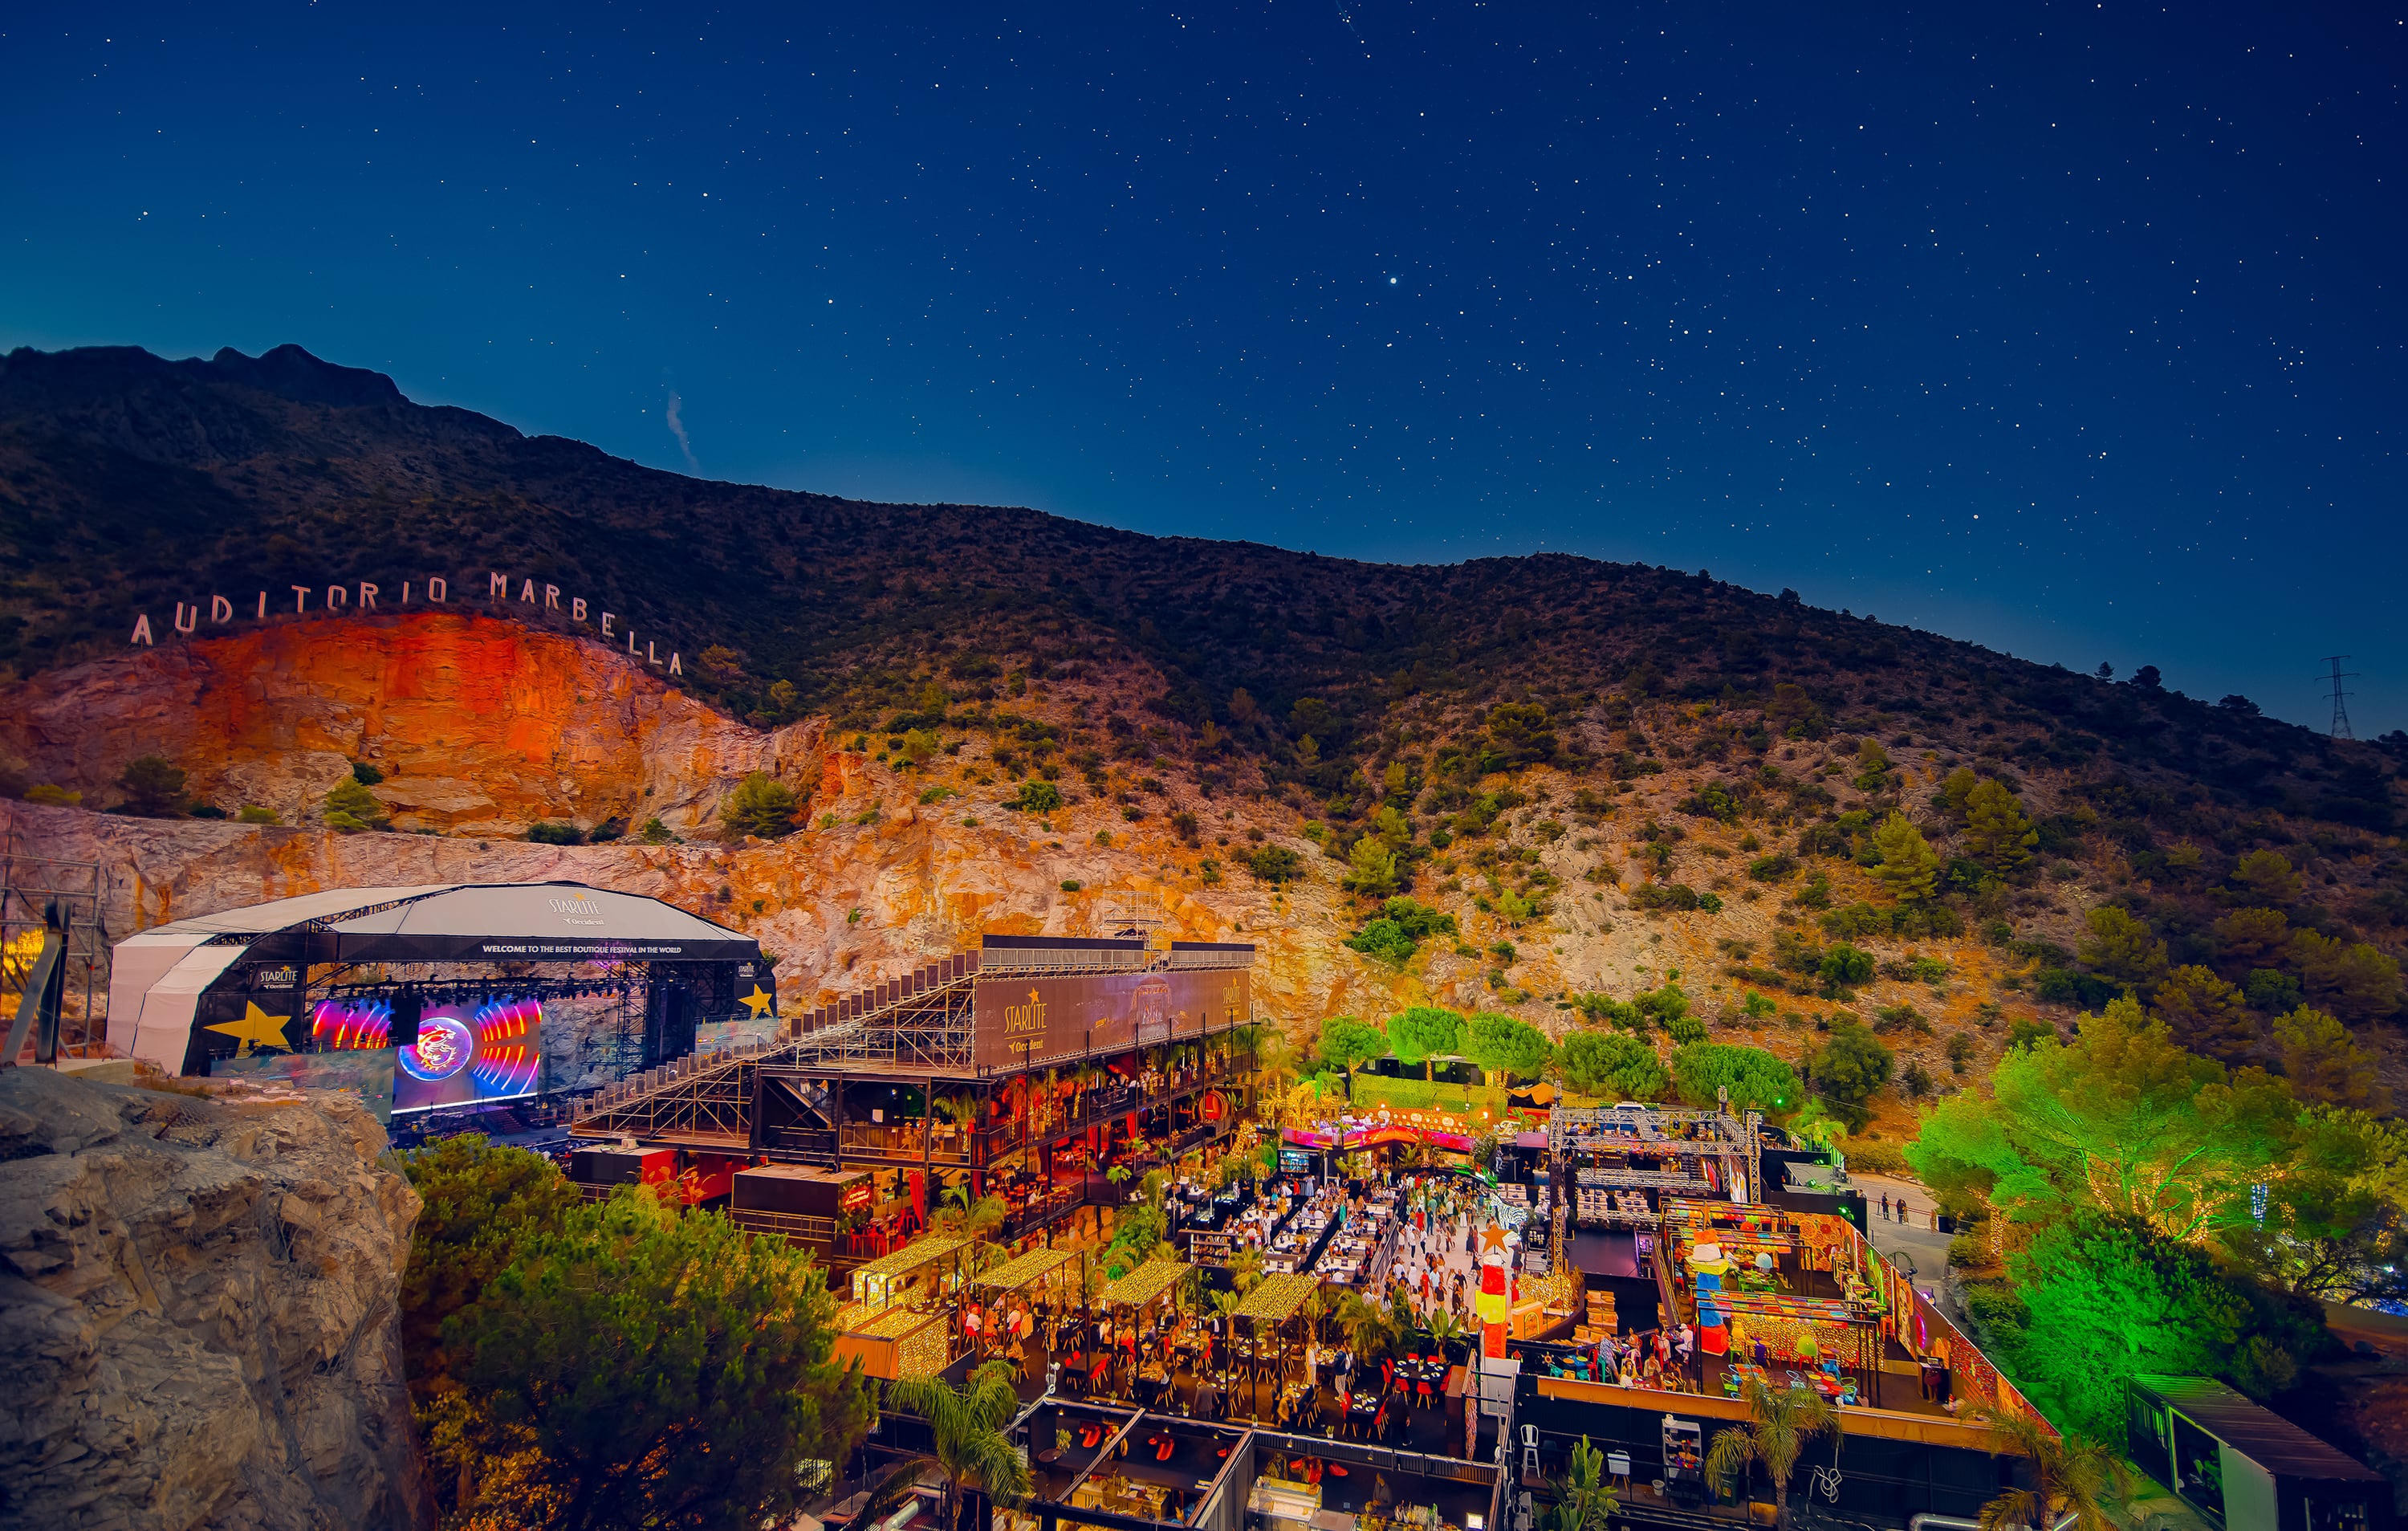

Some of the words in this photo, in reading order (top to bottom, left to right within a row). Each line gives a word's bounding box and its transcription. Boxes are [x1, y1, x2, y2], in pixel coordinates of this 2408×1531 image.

[131, 577, 445, 645] AUDITORIO
[490, 571, 682, 675] MARBELLA
[548, 898, 603, 914] STARLITE
[482, 945, 527, 953] WELCOME
[527, 945, 539, 953] TO
[260, 971, 298, 982] STARLITE
[1004, 1003, 1047, 1033] STARLITE
[1015, 1039, 1043, 1053] Occdent
